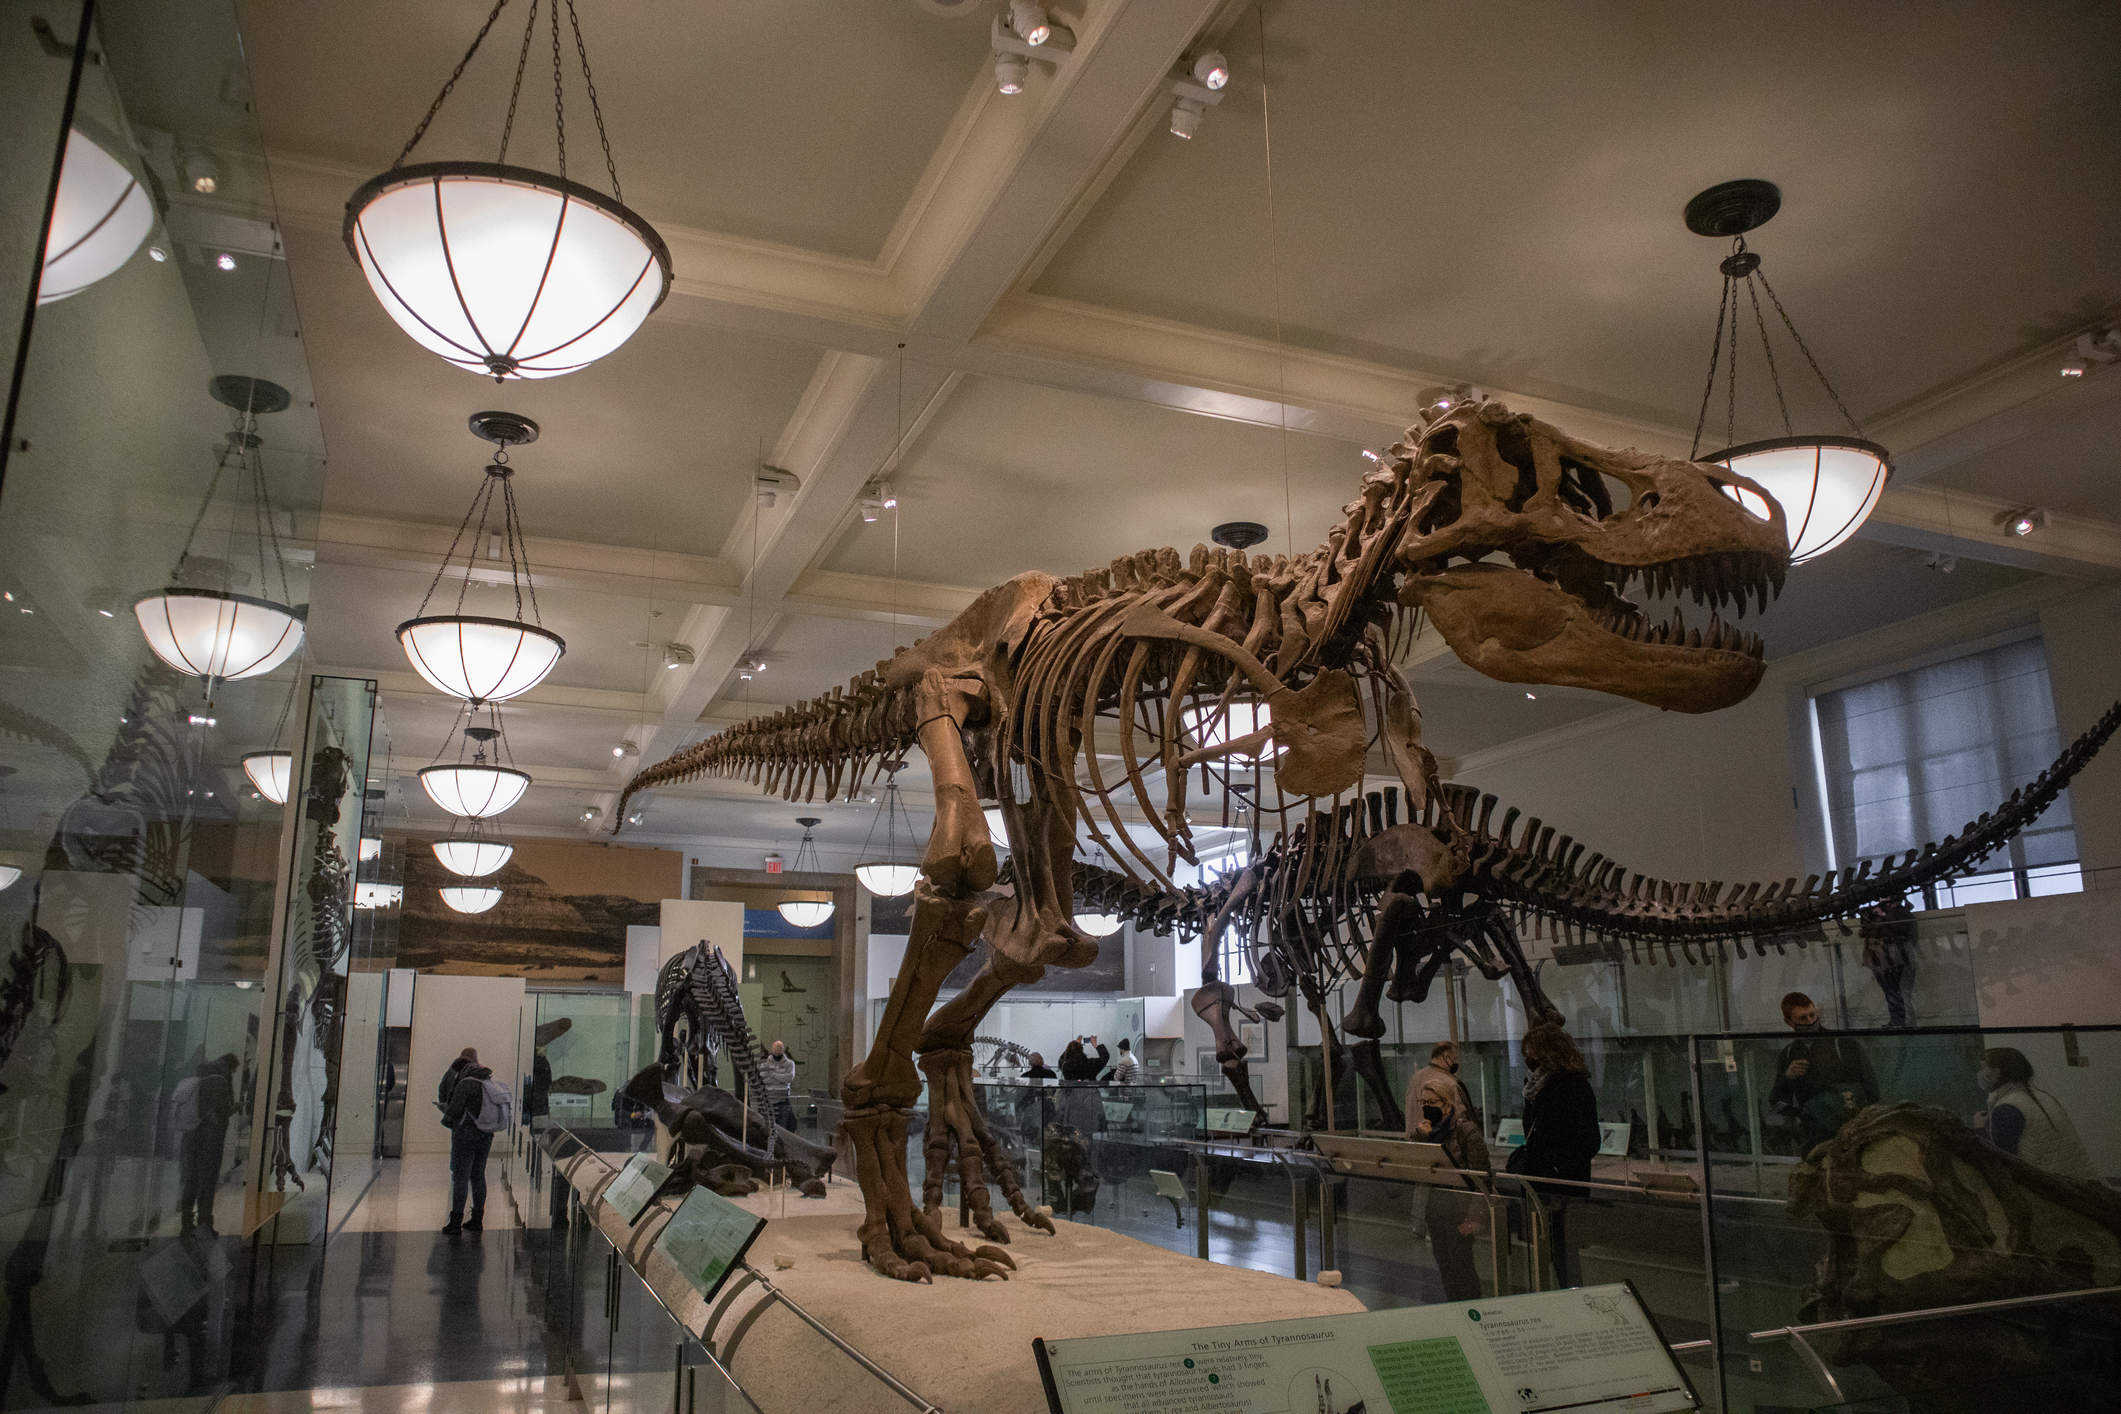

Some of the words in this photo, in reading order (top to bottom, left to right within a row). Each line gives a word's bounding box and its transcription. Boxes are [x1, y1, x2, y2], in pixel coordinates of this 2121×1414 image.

[768, 862, 781, 873] EXIT
[1479, 1318, 1530, 1331] Tyrannosaurus
[1191, 1342, 1210, 1352] The
[1211, 1340, 1231, 1350] Tiny
[1233, 1338, 1257, 1347] Arms
[1259, 1335, 1269, 1345] of
[1271, 1330, 1335, 1345] Tyrannosaurus
[1065, 1377, 1102, 1387] Scientists
[1103, 1374, 1134, 1384] thought
[1135, 1372, 1151, 1381] that
[1152, 1368, 1197, 1381] tyrannosaur
[1198, 1365, 1221, 1374] hands
[1221, 1363, 1236, 1372] had
[1237, 1362, 1243, 1370] 3
[1243, 1361, 1271, 1370] fingers,
[1067, 1369, 1082, 1378] The
[1084, 1368, 1102, 1376] arms
[1104, 1366, 1113, 1374] of
[1114, 1362, 1168, 1374] Tyrannosaurus
[1196, 1358, 1215, 1366] were
[1216, 1354, 1247, 1364] relatively
[1248, 1353, 1262, 1361] tiny
[1083, 1395, 1102, 1405] until
[1104, 1392, 1146, 1403] specimens
[1146, 1389, 1167, 1398] were
[1168, 1384, 1210, 1396] discovered
[1211, 1382, 1235, 1392] which
[1236, 1378, 1266, 1388] showed
[1120, 1383, 1134, 1391] the
[1135, 1380, 1158, 1390] hands
[1159, 1379, 1167, 1387] of
[1169, 1376, 1206, 1386] Allosaurus
[1220, 1373, 1235, 1382] did.
[1123, 1401, 1140, 1410] that
[1141, 1399, 1151, 1408] all
[1151, 1395, 1187, 1407] advanced
[1188, 1391, 1234, 1404] tyrannosaurs
[1171, 1406, 1183, 1414] rex
[1184, 1404, 1199, 1413] and
[1200, 1397, 1252, 1411] Albertosaurus)
